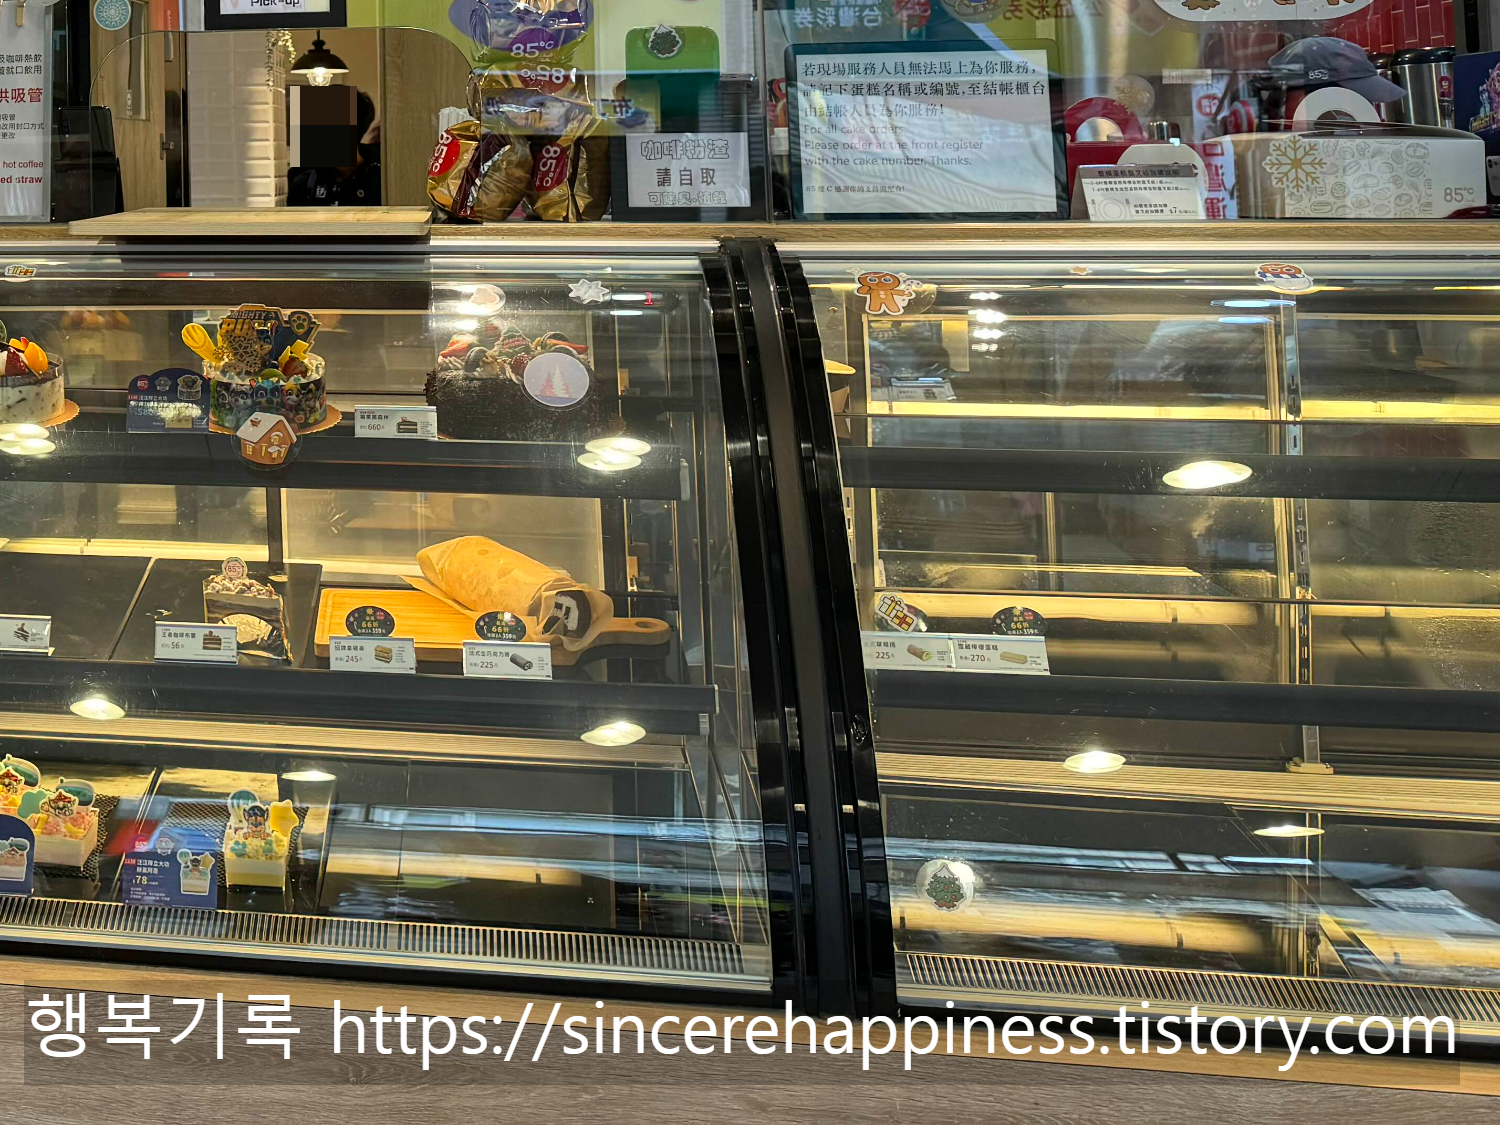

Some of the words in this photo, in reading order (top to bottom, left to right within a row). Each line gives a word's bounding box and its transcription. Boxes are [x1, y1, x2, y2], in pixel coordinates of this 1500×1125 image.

[804, 125, 822, 134] For
[824, 125, 837, 134] all
[840, 125, 866, 134] cake
[869, 125, 904, 134] orders
[641, 139, 730, 160] 咖啡粉渣
[804, 141, 839, 150] Please
[842, 141, 872, 150] order
[876, 141, 886, 150] at
[889, 141, 908, 150] the
[911, 140, 939, 150] front
[942, 140, 984, 152] register
[2, 161, 16, 169] hot
[18, 160, 44, 169] coffee
[804, 156, 829, 166] with
[831, 156, 850, 166] the
[853, 156, 878, 166] cake
[930, 156, 973, 166] Thanks.
[15, 176, 43, 184] straw
[656, 167, 716, 187] 請自取
[230, 310, 267, 320] MIGHTY
[368, 423, 381, 431] 660
[345, 655, 359, 663] 245
[875, 651, 891, 660] 225
[970, 654, 986, 662] 270
[480, 661, 494, 669] 225
